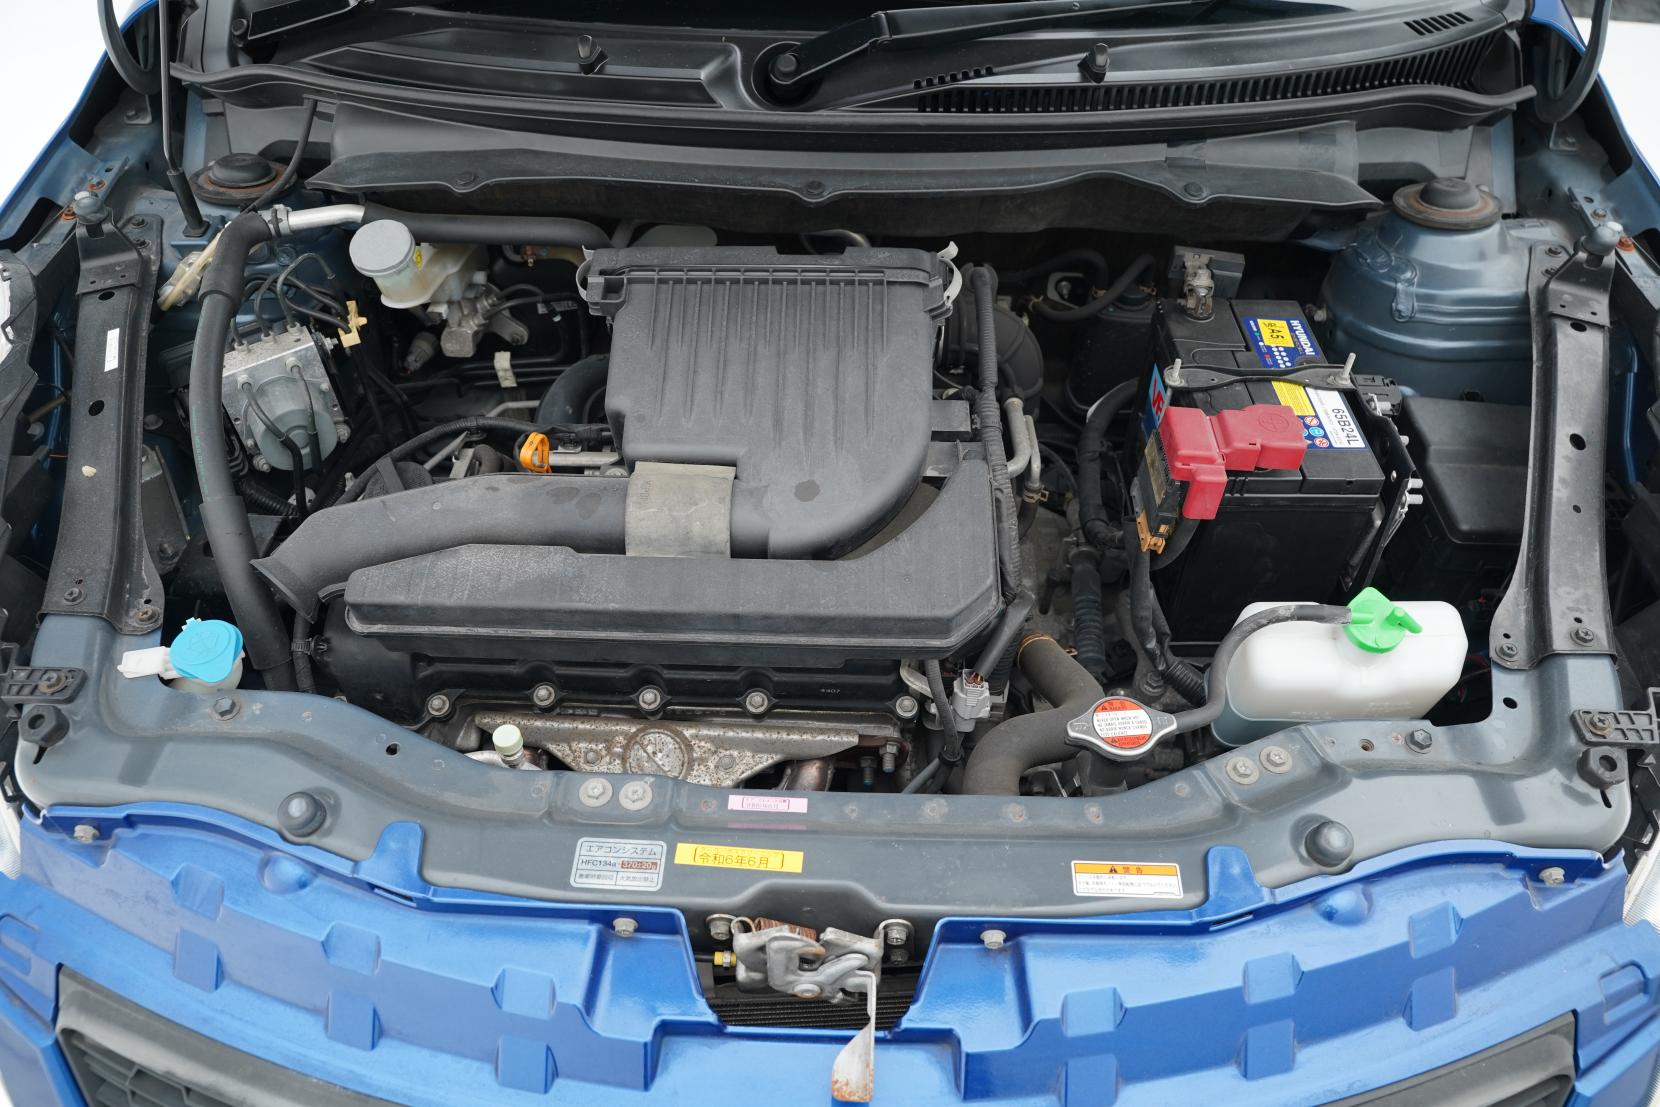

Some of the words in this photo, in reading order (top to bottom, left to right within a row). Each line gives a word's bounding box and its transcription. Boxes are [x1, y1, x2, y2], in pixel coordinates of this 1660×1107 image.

[1289, 319, 1316, 356] HYUNDAI
[1332, 408, 1360, 446] 65B24L
[586, 844, 657, 856] エアコンシステム
[581, 859, 617, 868] HFC134a
[698, 851, 769, 869] 令和6年6月
